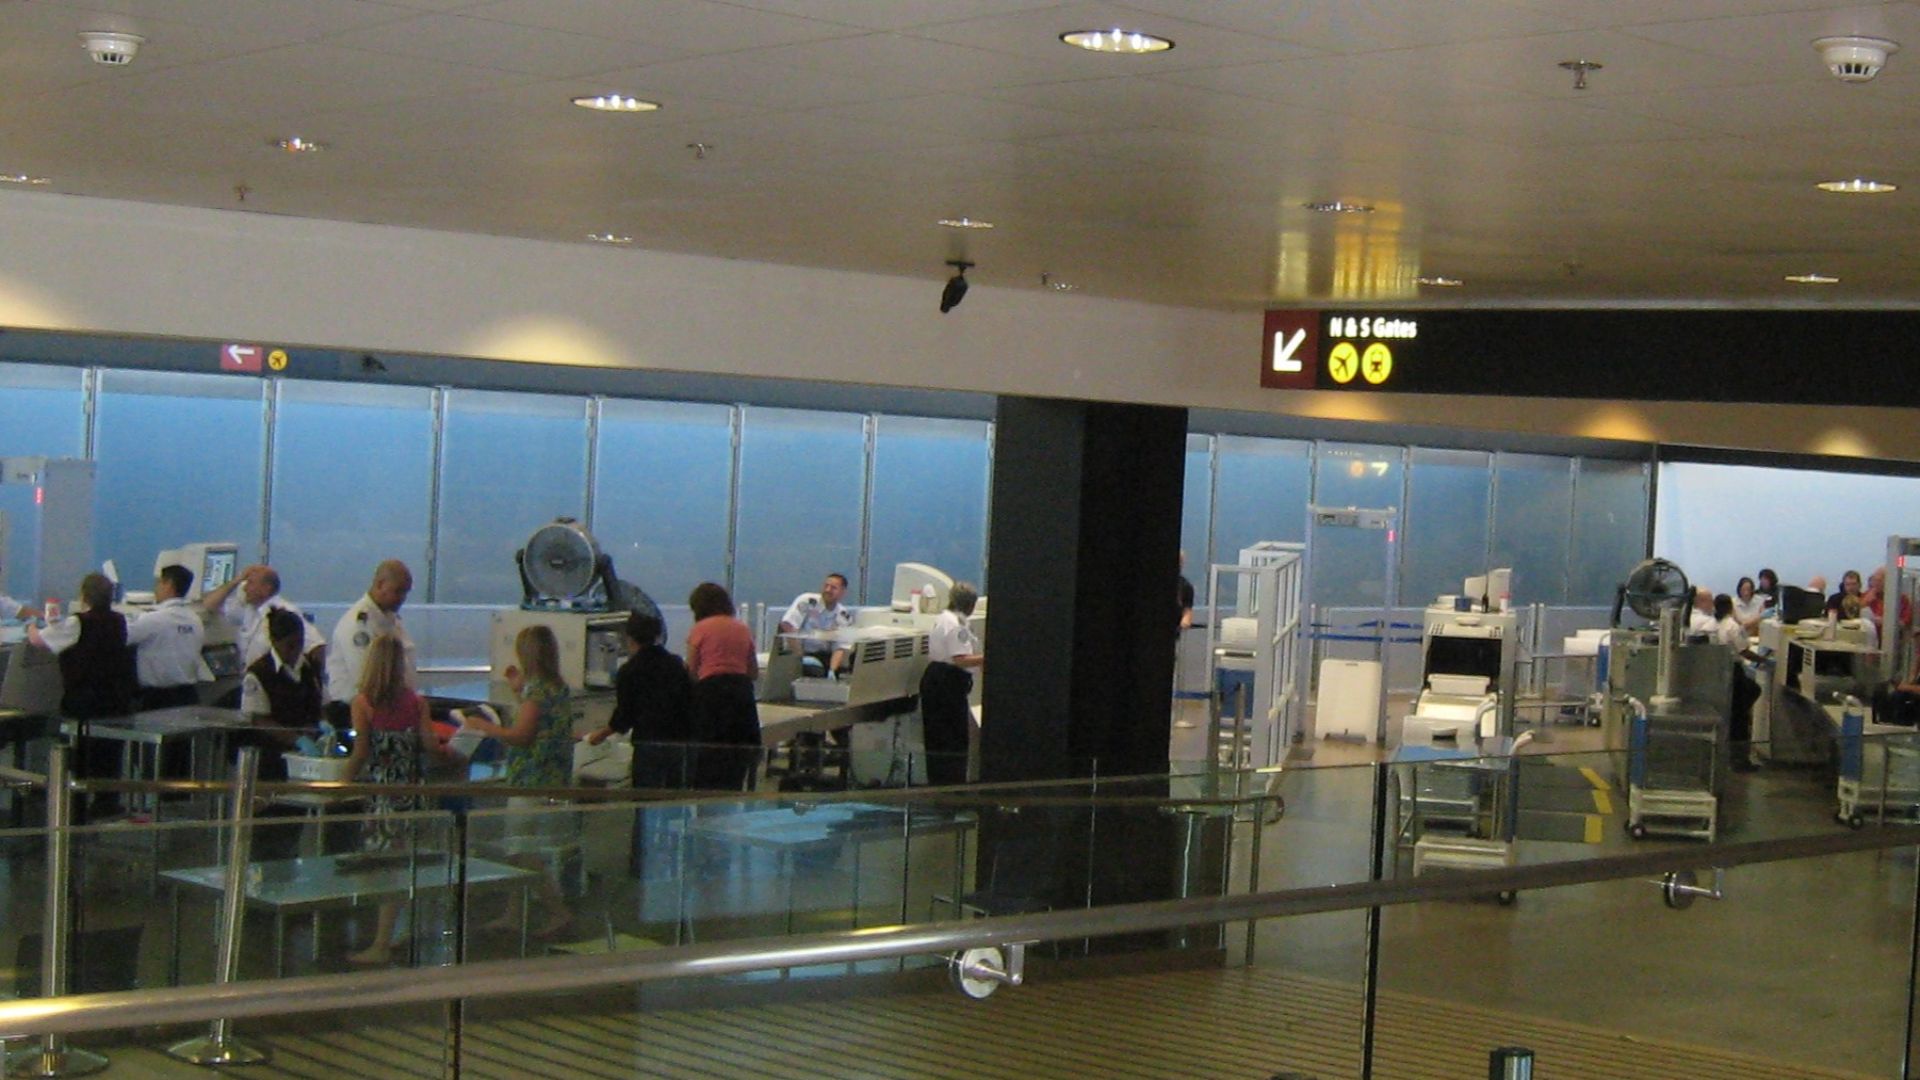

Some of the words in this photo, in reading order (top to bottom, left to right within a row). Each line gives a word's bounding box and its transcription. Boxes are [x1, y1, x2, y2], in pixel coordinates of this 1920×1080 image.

[1329, 317, 1343, 338] N
[1345, 317, 1358, 338] &
[1360, 317, 1370, 338] S
[1372, 317, 1417, 338] Gates
